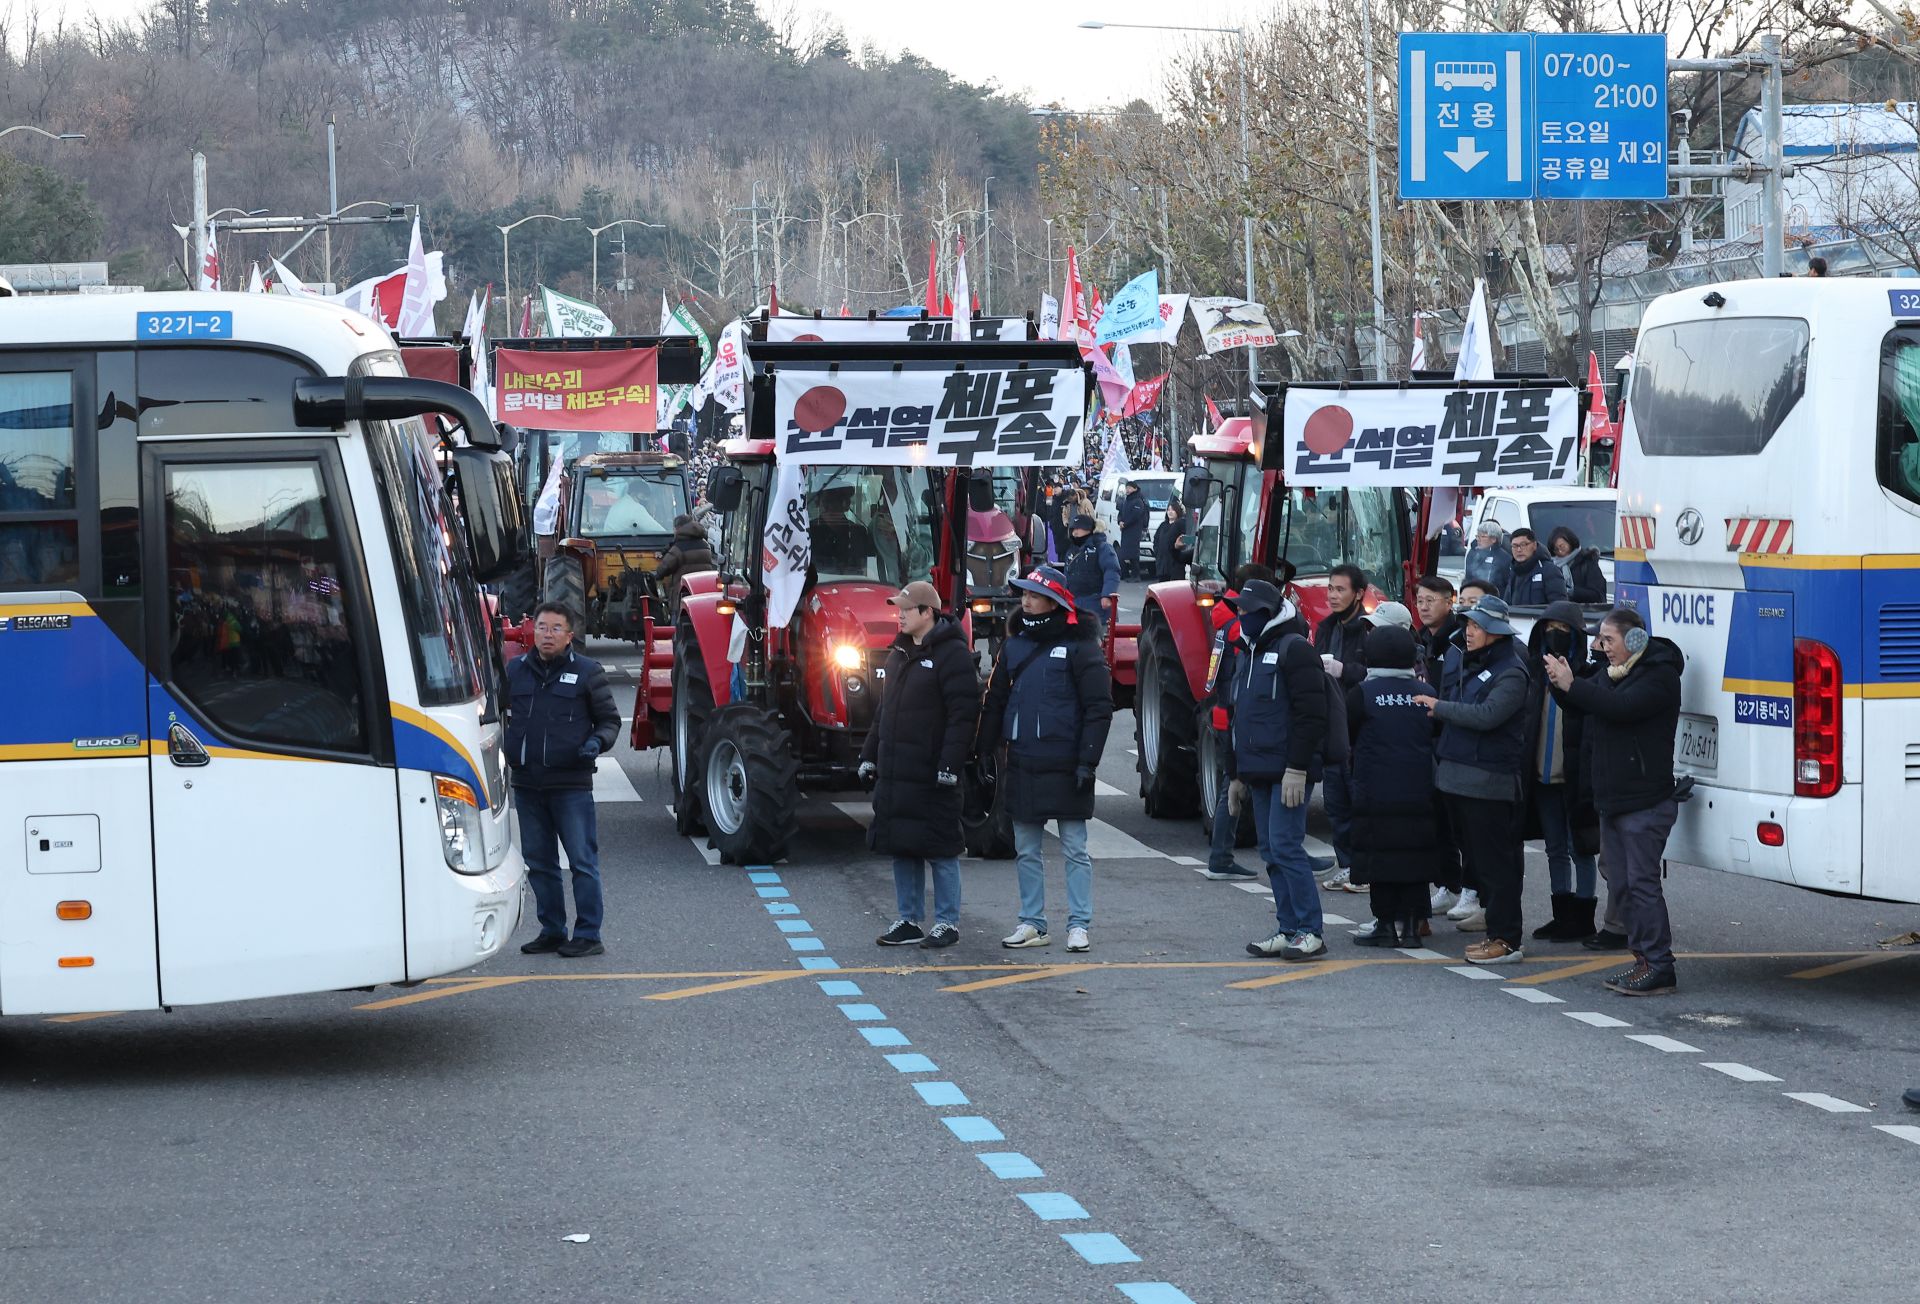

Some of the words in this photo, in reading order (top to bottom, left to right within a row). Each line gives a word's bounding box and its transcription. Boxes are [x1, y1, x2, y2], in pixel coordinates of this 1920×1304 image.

[1544, 53, 1631, 78] 07:00~
[1594, 84, 1657, 108] 21:00
[1542, 121, 1609, 144] 토요일
[1617, 141, 1662, 164] 제외
[1542, 157, 1610, 181] 공휴일
[148, 315, 222, 335] 32기-2
[504, 370, 582, 391] 내란수괴
[505, 392, 563, 412] 윤석열
[566, 384, 650, 410] 체포구속!
[935, 369, 1058, 420] 체포
[1438, 389, 1553, 440] 체포
[937, 412, 1081, 466] 구속!
[1442, 434, 1576, 486] 구속!
[1663, 592, 1715, 626] POLICE
[17, 615, 69, 629] ELEGANCE
[1737, 699, 1790, 721] 32기동대-3
